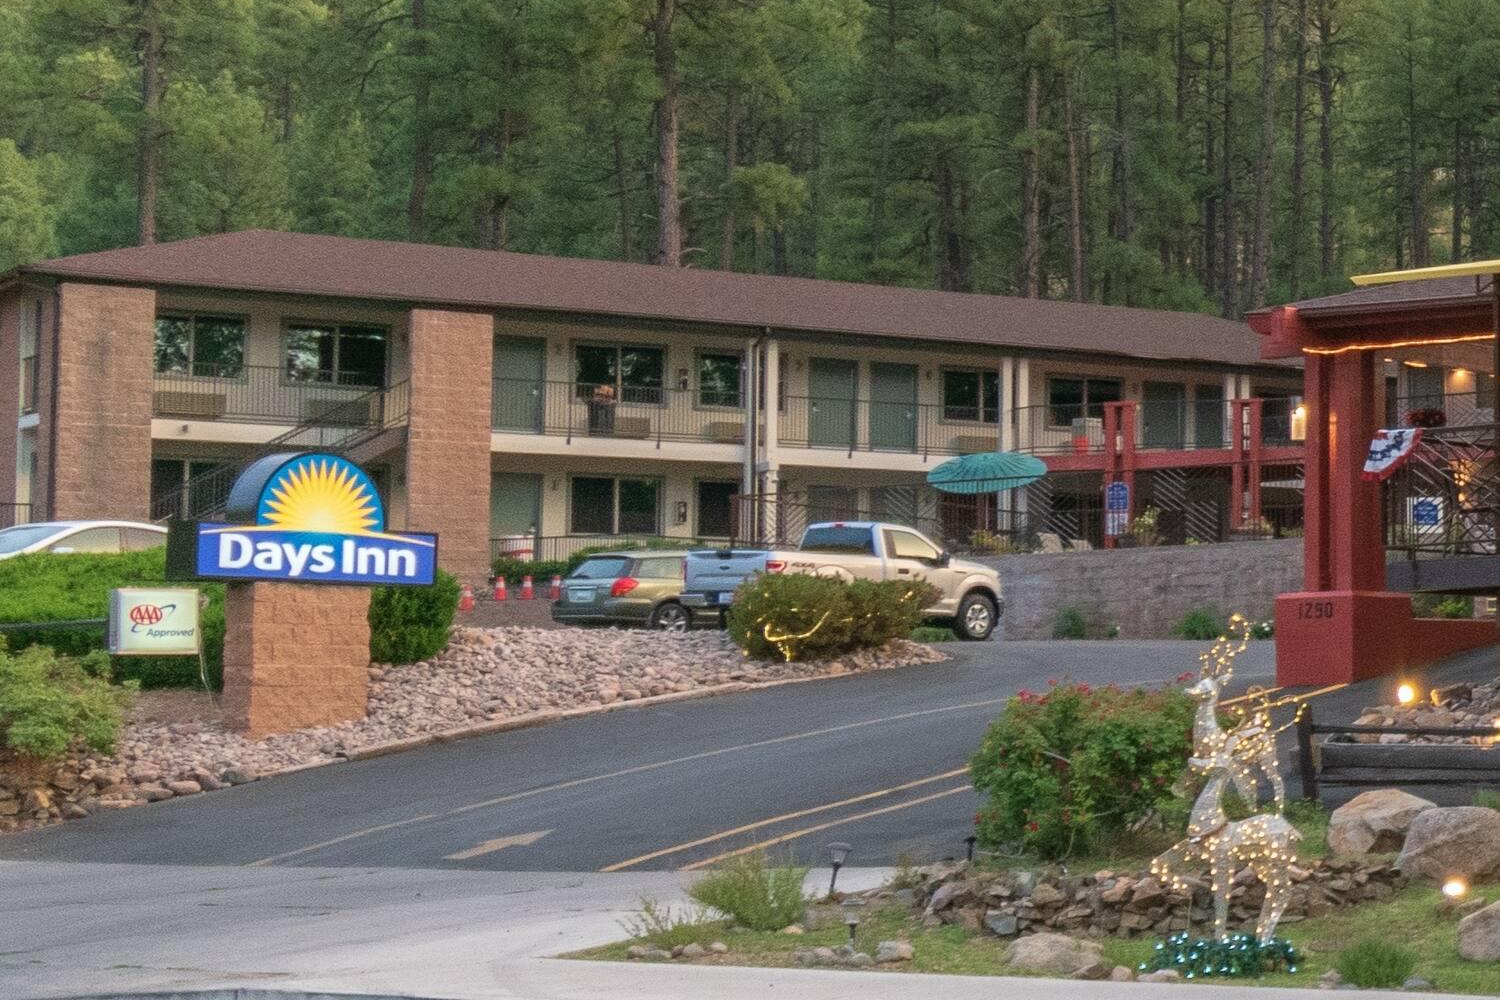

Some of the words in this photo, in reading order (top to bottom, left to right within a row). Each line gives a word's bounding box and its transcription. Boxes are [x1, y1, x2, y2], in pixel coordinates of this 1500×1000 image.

[218, 533, 335, 576] Days
[342, 540, 416, 577] Inn
[133, 605, 161, 625] AAA
[1298, 602, 1333, 620] 1290
[146, 628, 195, 638] Approved
